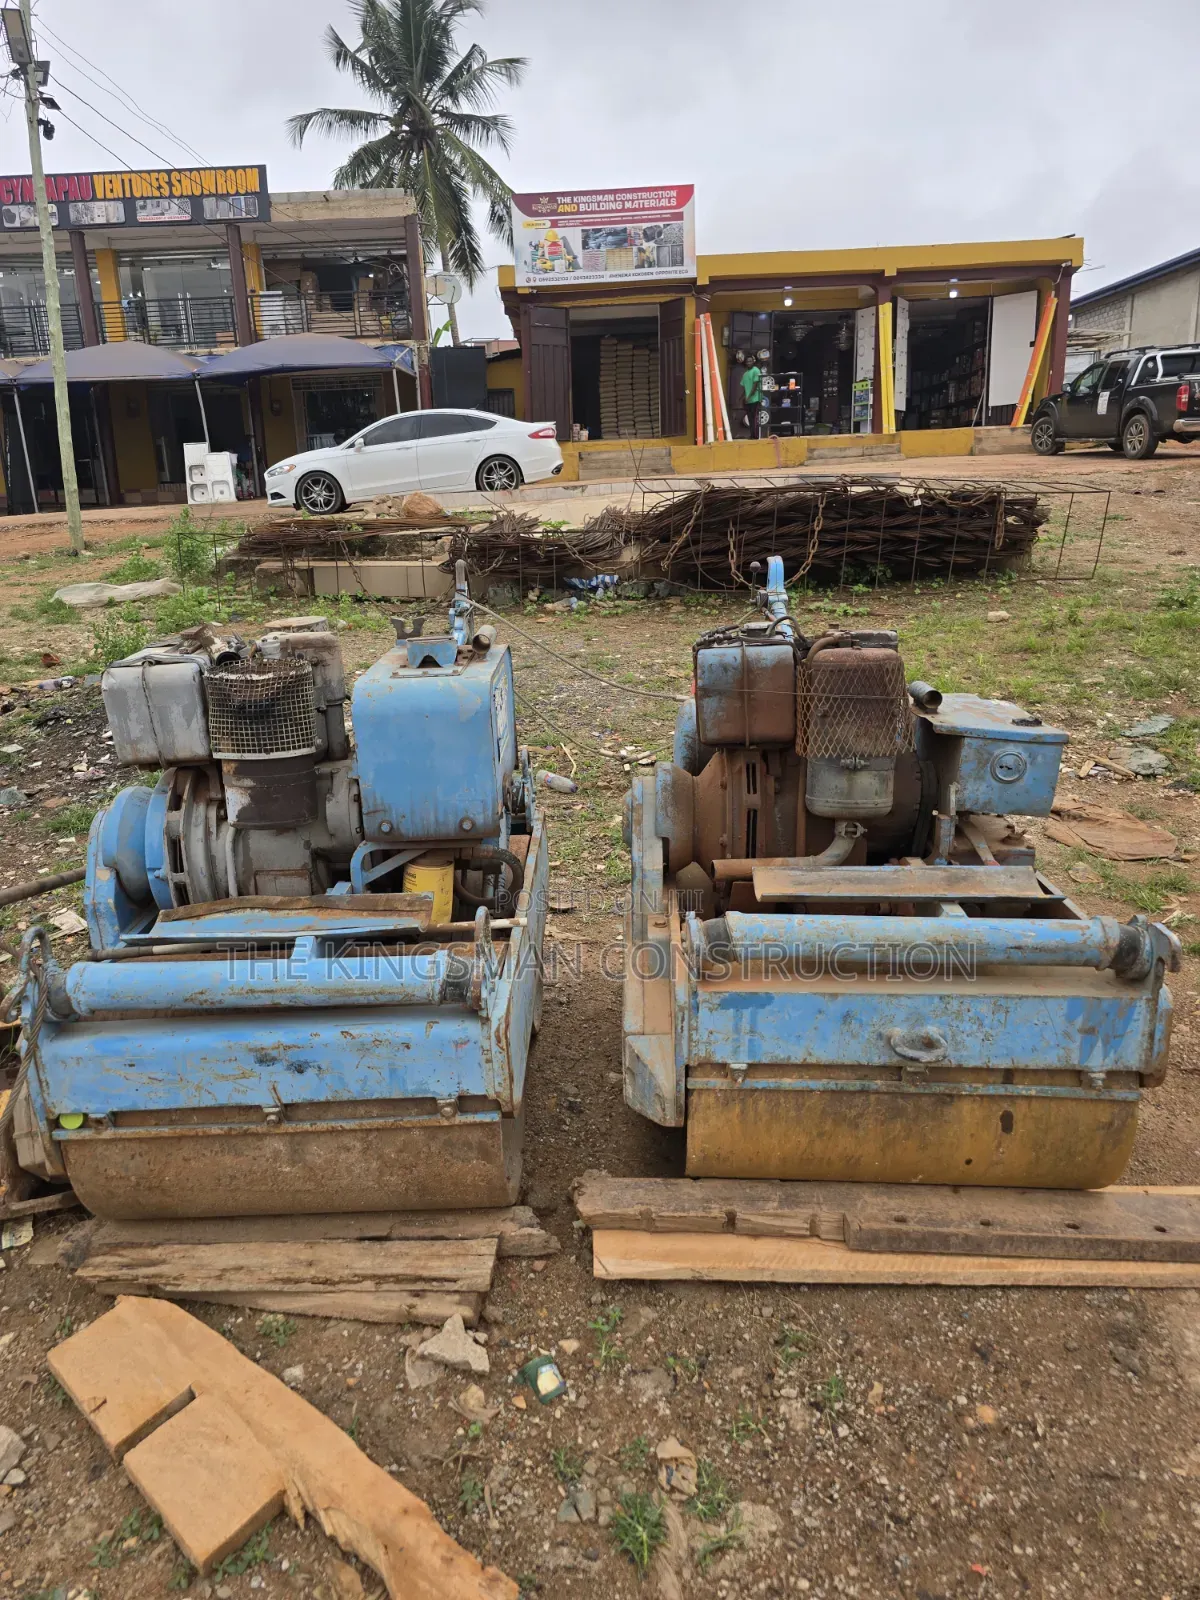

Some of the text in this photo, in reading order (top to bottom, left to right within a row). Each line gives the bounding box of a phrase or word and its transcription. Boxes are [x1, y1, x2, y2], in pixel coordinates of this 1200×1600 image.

[92, 171, 170, 199] VENTURES
[171, 168, 260, 197] SHOWROOM
[556, 190, 677, 204] THE KINGSMAN CONSTRUCTION
[557, 203, 578, 213] AND
[579, 201, 622, 212] BUILDING
[624, 198, 677, 209] MATERIALS
